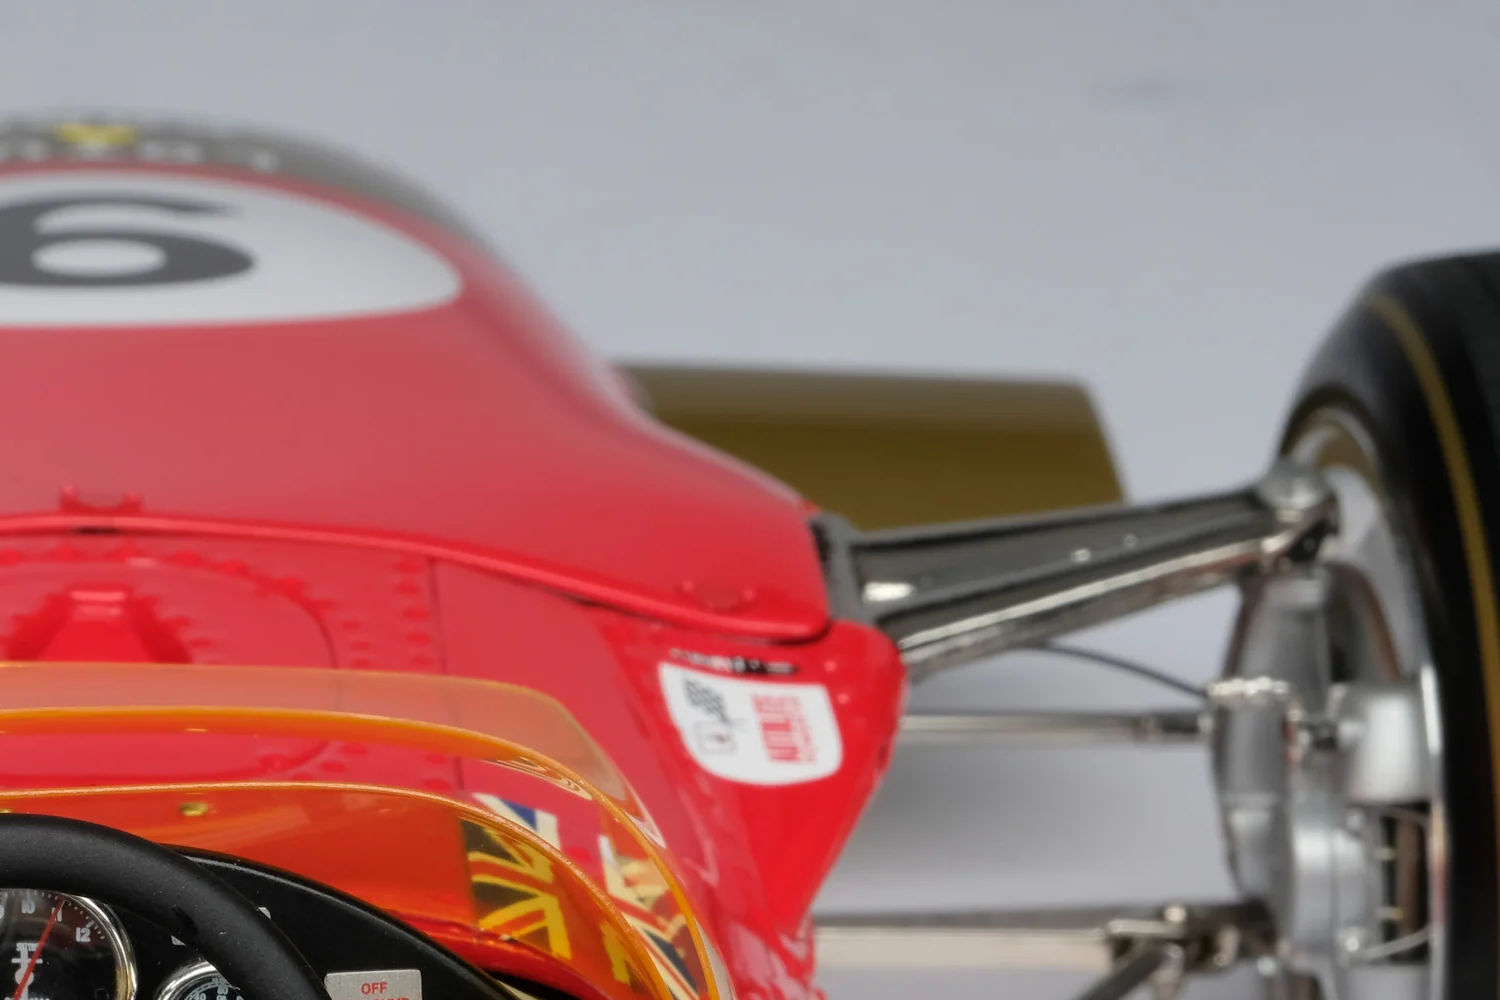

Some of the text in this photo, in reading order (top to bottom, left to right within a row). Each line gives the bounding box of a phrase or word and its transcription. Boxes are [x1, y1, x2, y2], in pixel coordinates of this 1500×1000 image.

[21, 901, 35, 914] 10
[76, 927, 91, 942] 12
[360, 981, 388, 995] OFF
